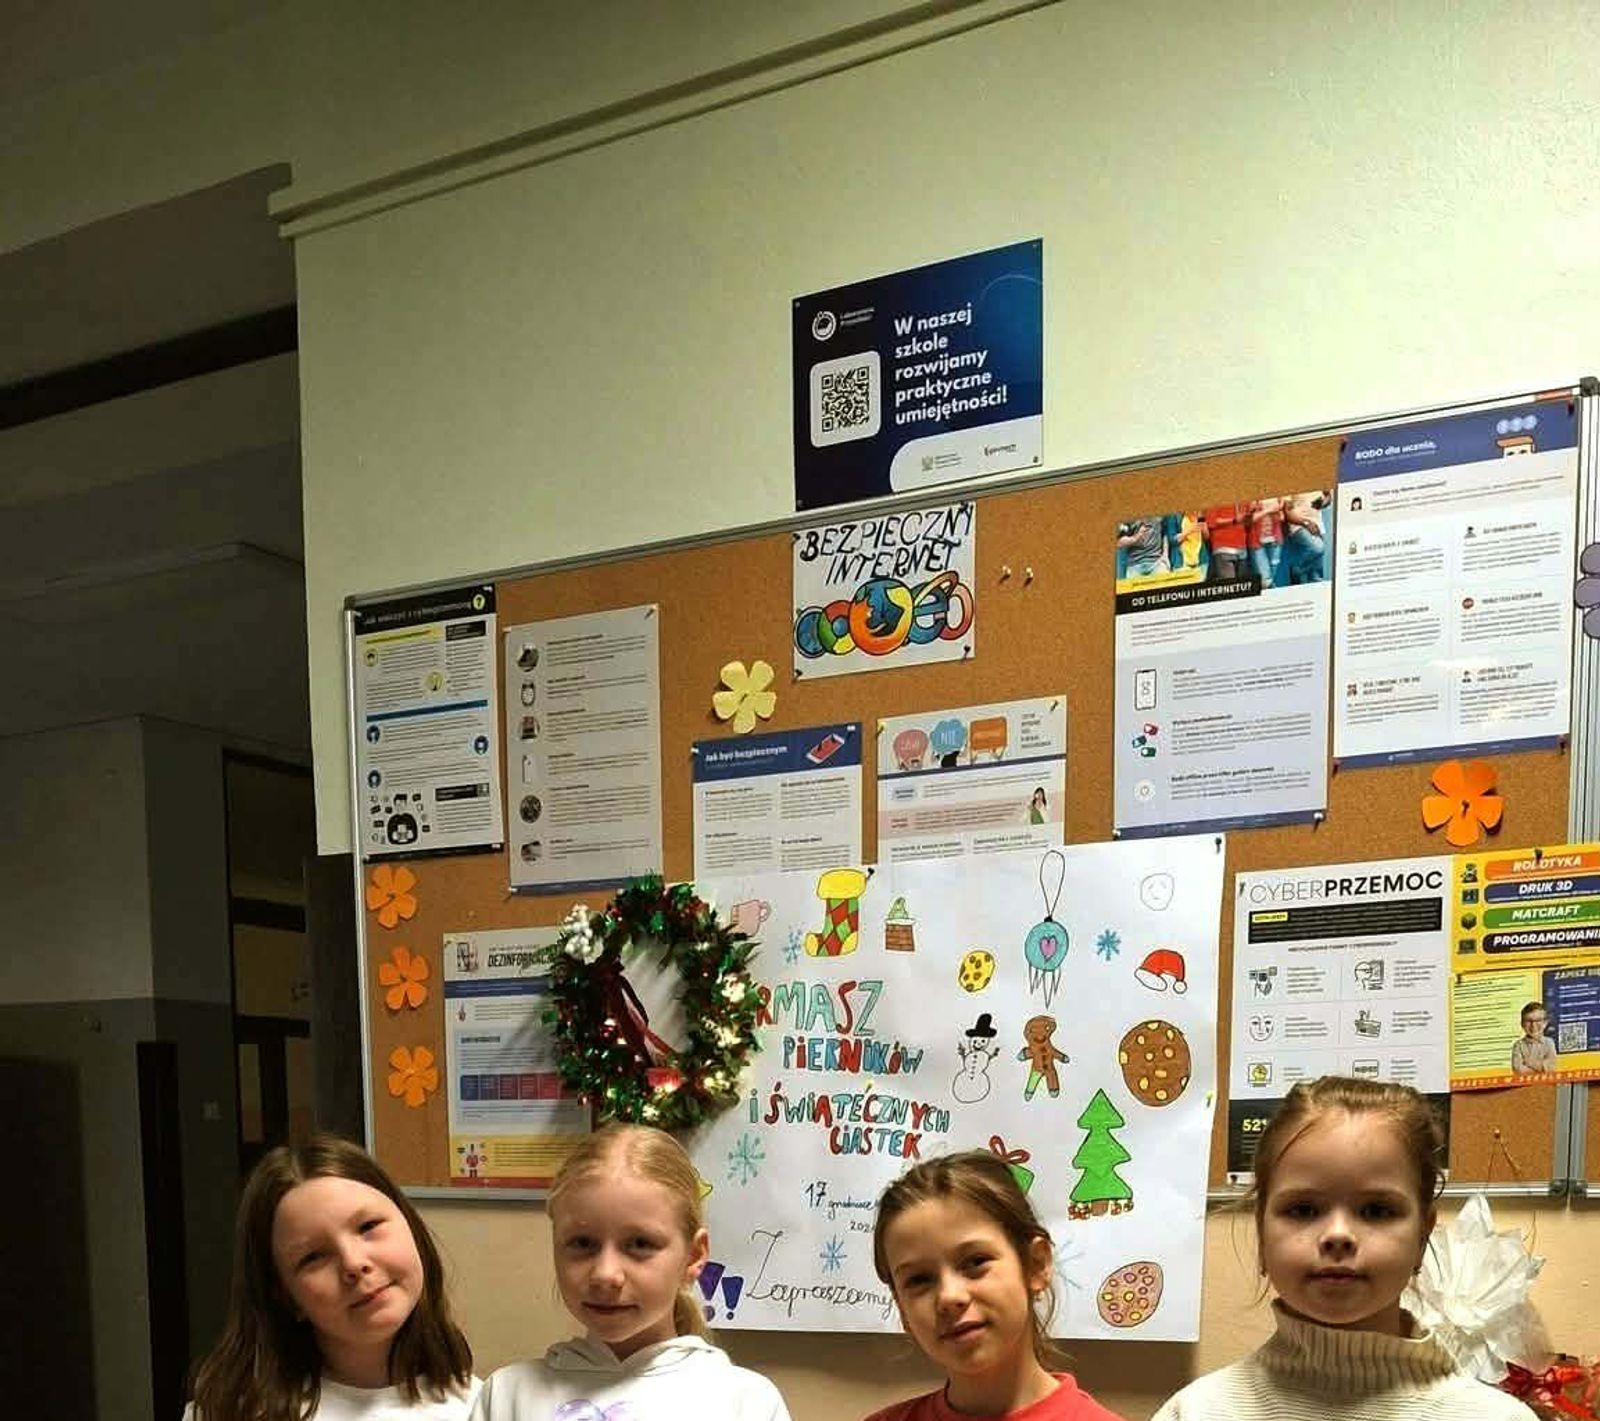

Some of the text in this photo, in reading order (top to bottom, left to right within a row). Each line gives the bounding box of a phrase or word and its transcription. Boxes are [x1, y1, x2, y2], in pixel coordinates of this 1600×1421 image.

[894, 316, 913, 336] W
[917, 302, 972, 332] naszej
[895, 332, 948, 359] szkole
[895, 350, 988, 382] rozwijamy
[895, 372, 992, 408] praktyczne
[895, 385, 1008, 425] umiejętności!
[800, 503, 973, 562] BEZPIECZNY
[825, 538, 961, 586] INTERNET
[1147, 591, 1191, 604] TELEFONU
[1250, 870, 1444, 904] CYBERPRZEMOC
[1519, 880, 1573, 895] DRUK 3D
[1512, 905, 1580, 920] MATCRAFT
[755, 979, 884, 1037] RMASZ
[804, 1180, 827, 1209] 17
